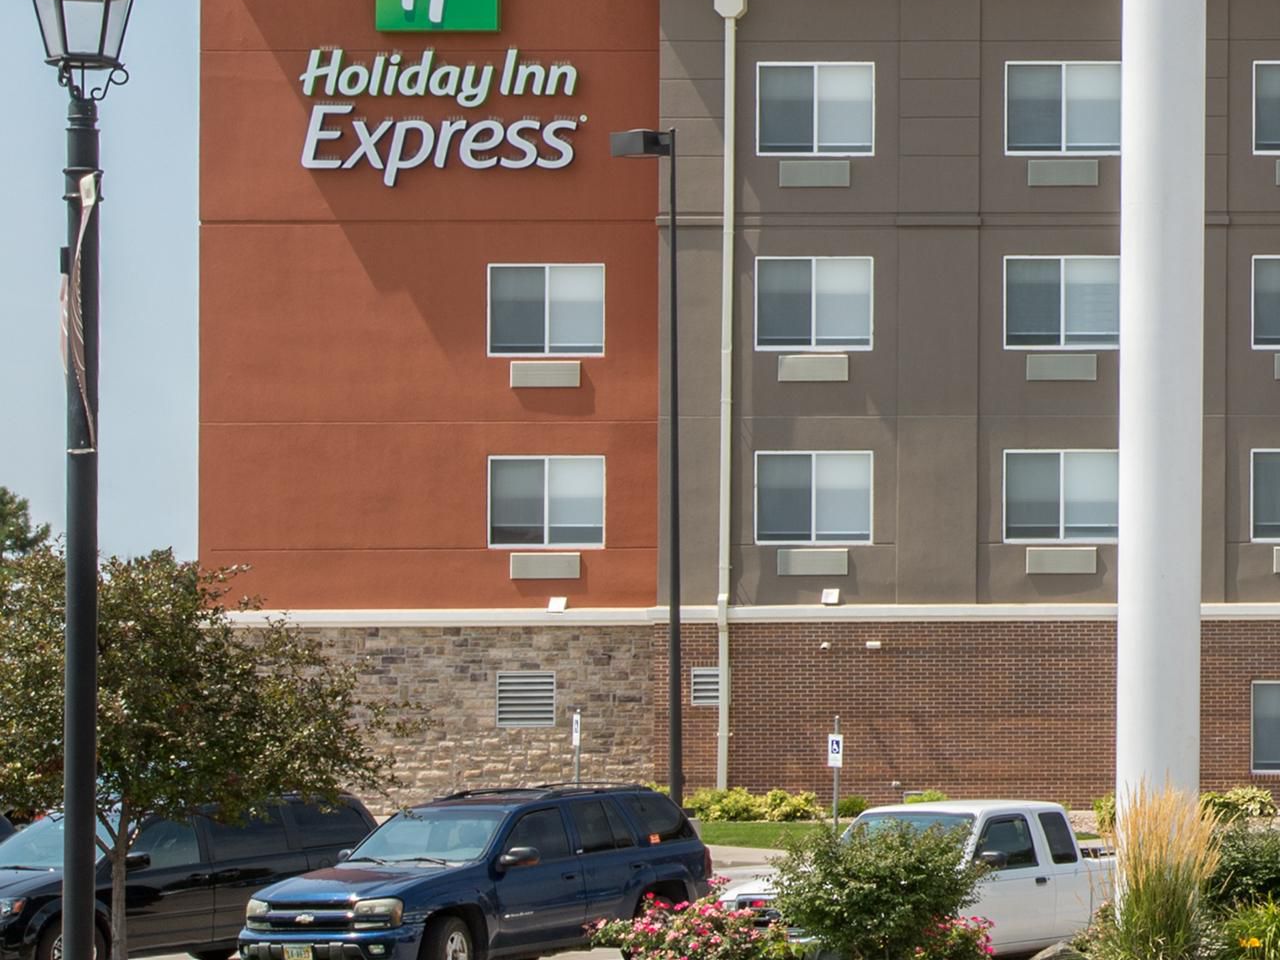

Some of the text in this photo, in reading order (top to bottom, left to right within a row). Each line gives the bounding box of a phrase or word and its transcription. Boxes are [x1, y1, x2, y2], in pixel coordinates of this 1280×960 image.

[300, 48, 578, 109] Holiday Inn
[301, 104, 578, 188] Express
